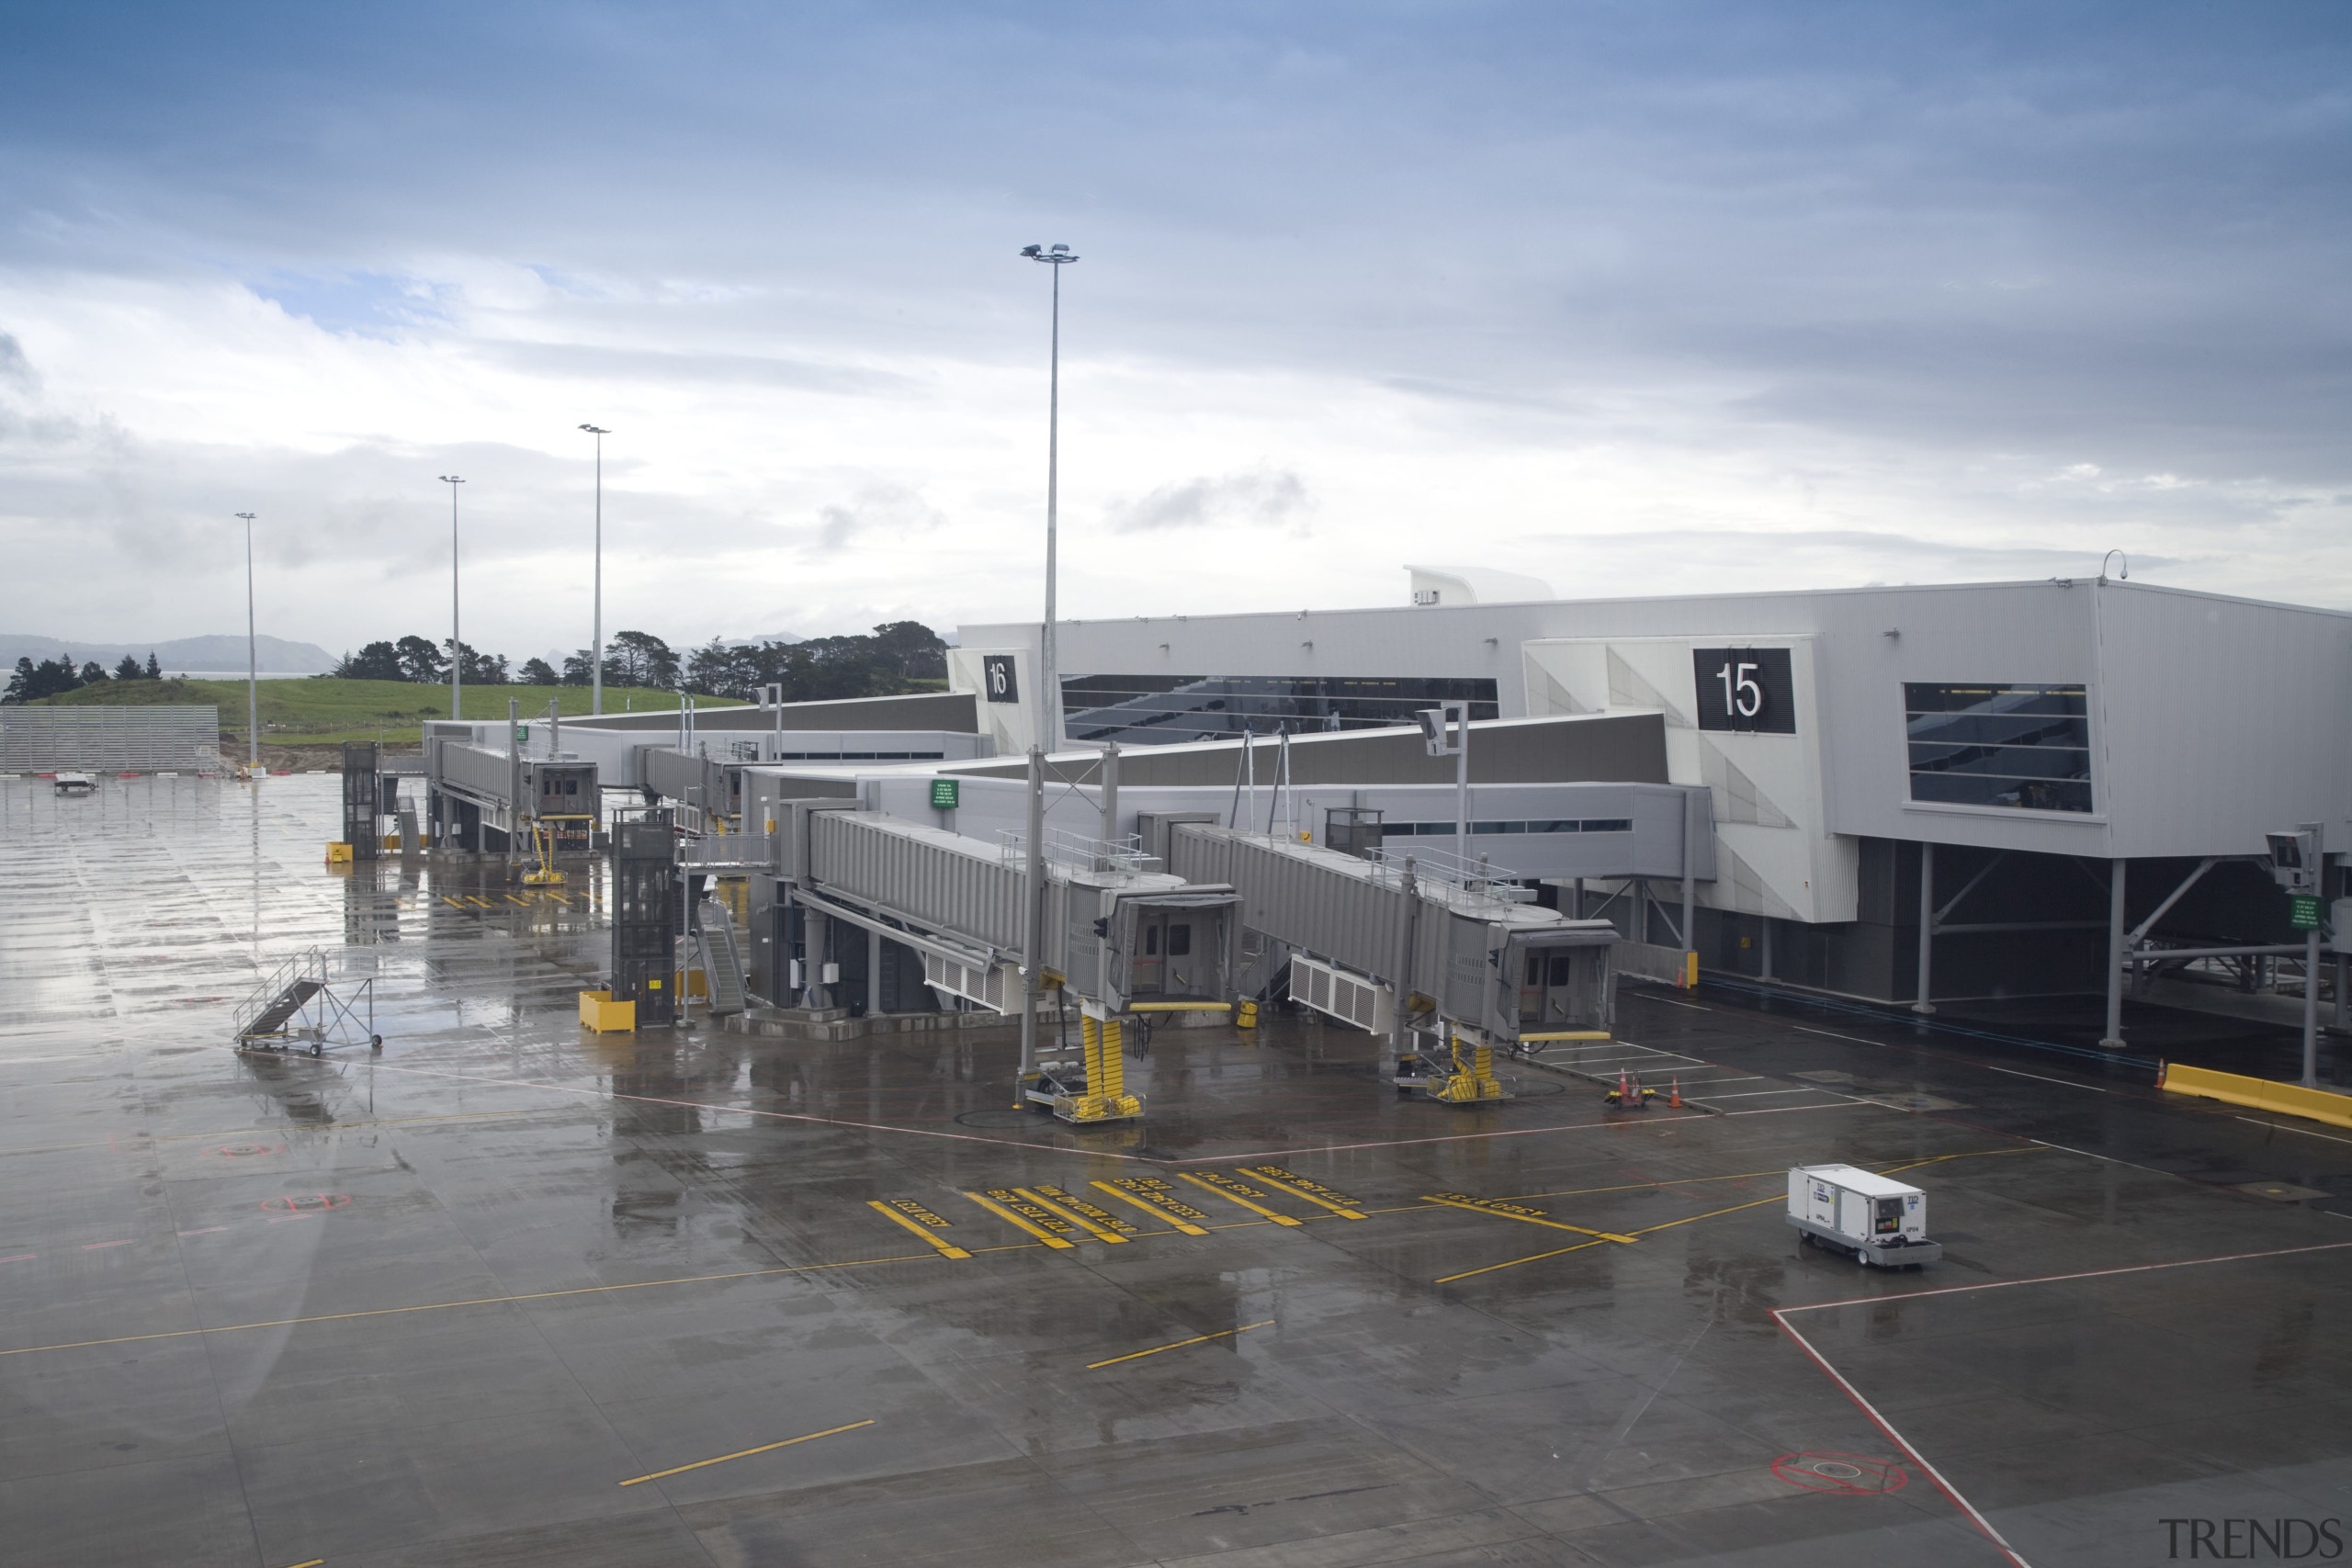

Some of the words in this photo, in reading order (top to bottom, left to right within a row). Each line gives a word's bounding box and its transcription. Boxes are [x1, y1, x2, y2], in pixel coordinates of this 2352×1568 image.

[989, 662, 1007, 694] 16
[1716, 662, 1762, 716] 15
[1011, 1203, 1049, 1218] B757
[1490, 1202, 1547, 1215] A320
[914, 1213, 952, 1227] A320
[1036, 1218, 1076, 1233] B727
